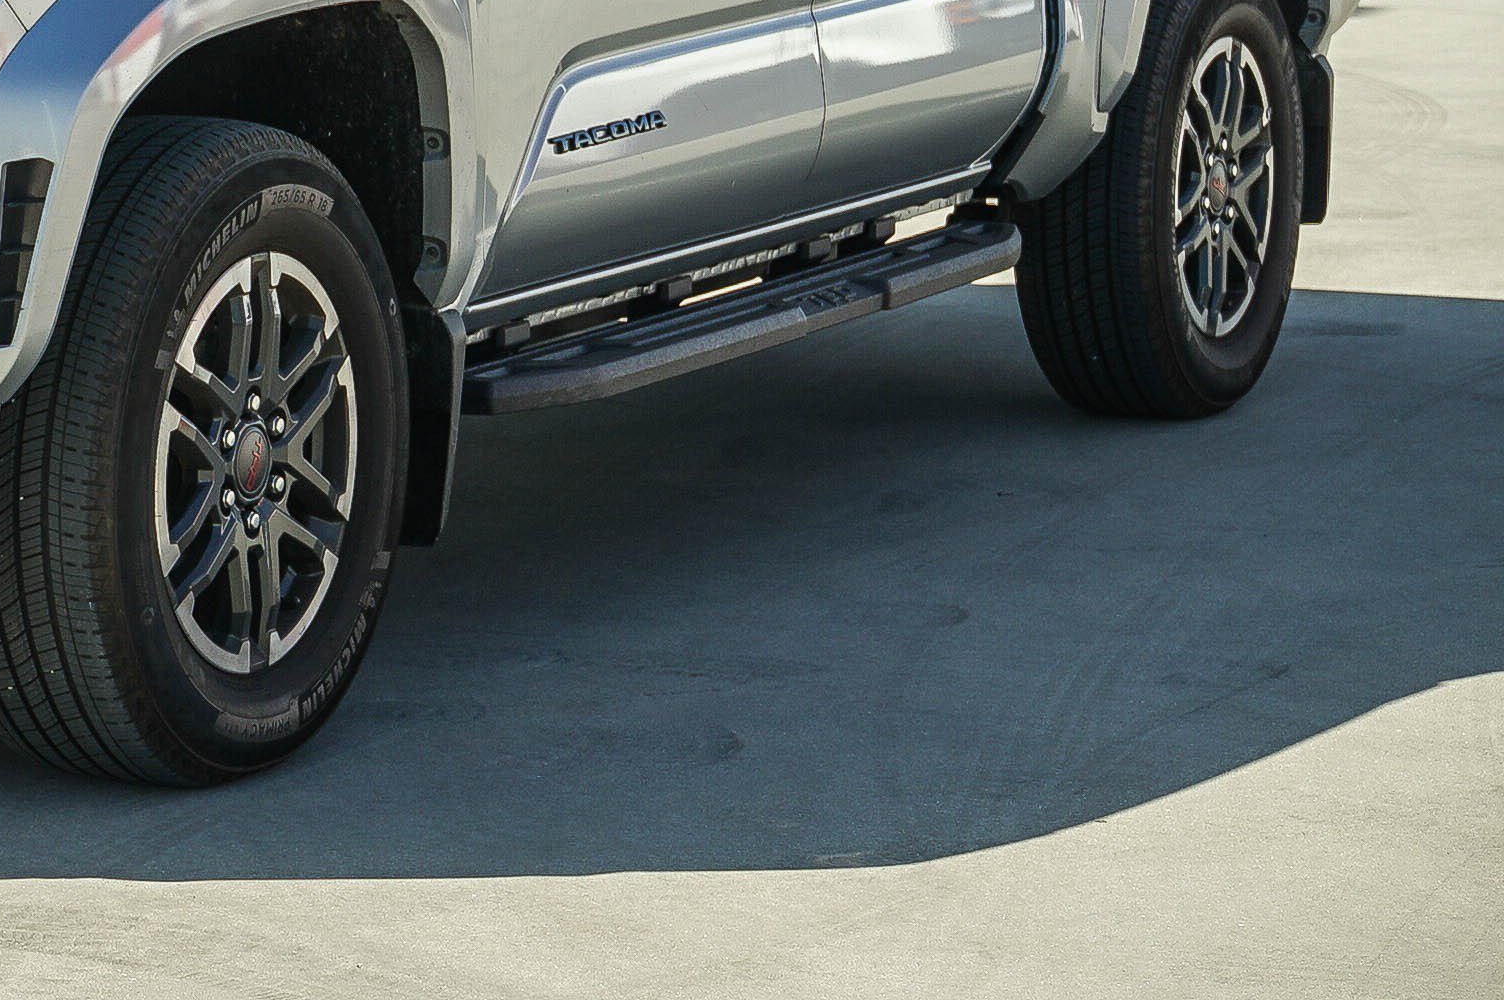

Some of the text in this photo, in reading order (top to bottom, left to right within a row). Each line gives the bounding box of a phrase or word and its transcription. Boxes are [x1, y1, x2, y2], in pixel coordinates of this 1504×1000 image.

[547, 110, 667, 154] TACOMA
[184, 201, 258, 304] MICHELIN
[301, 612, 367, 720] MICHELIN
